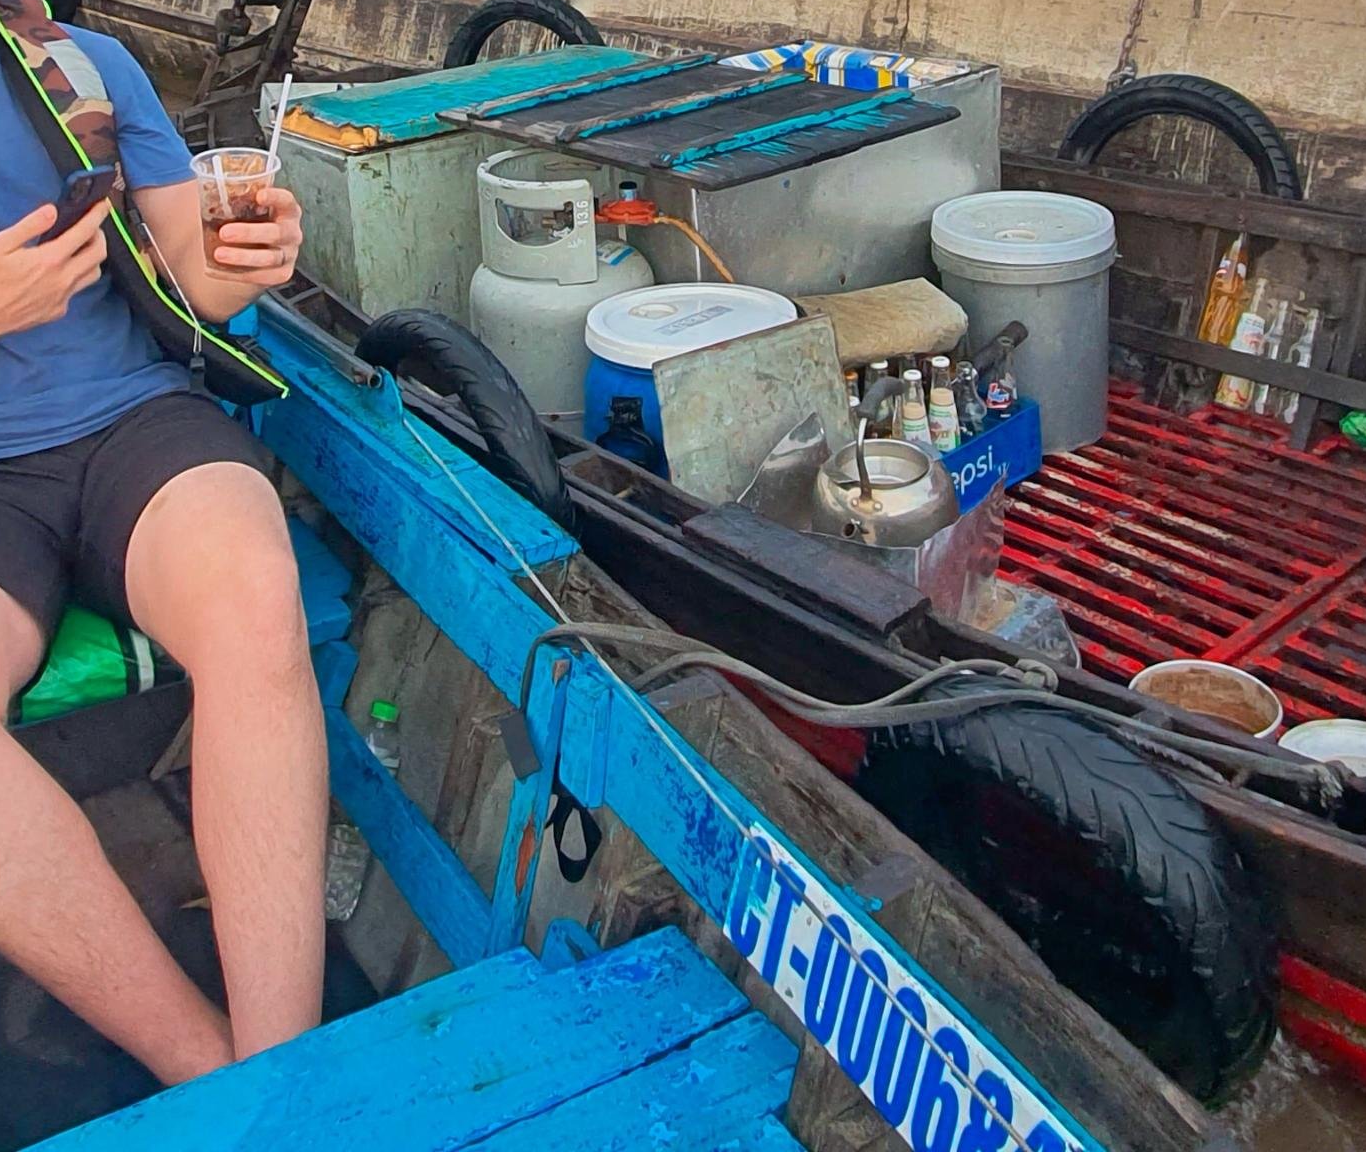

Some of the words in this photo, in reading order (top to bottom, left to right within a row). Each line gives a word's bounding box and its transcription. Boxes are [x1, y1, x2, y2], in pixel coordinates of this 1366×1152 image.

[576, 200, 589, 229] 13.6
[950, 445, 993, 496] epsi
[728, 835, 1068, 1152] CT-00068
